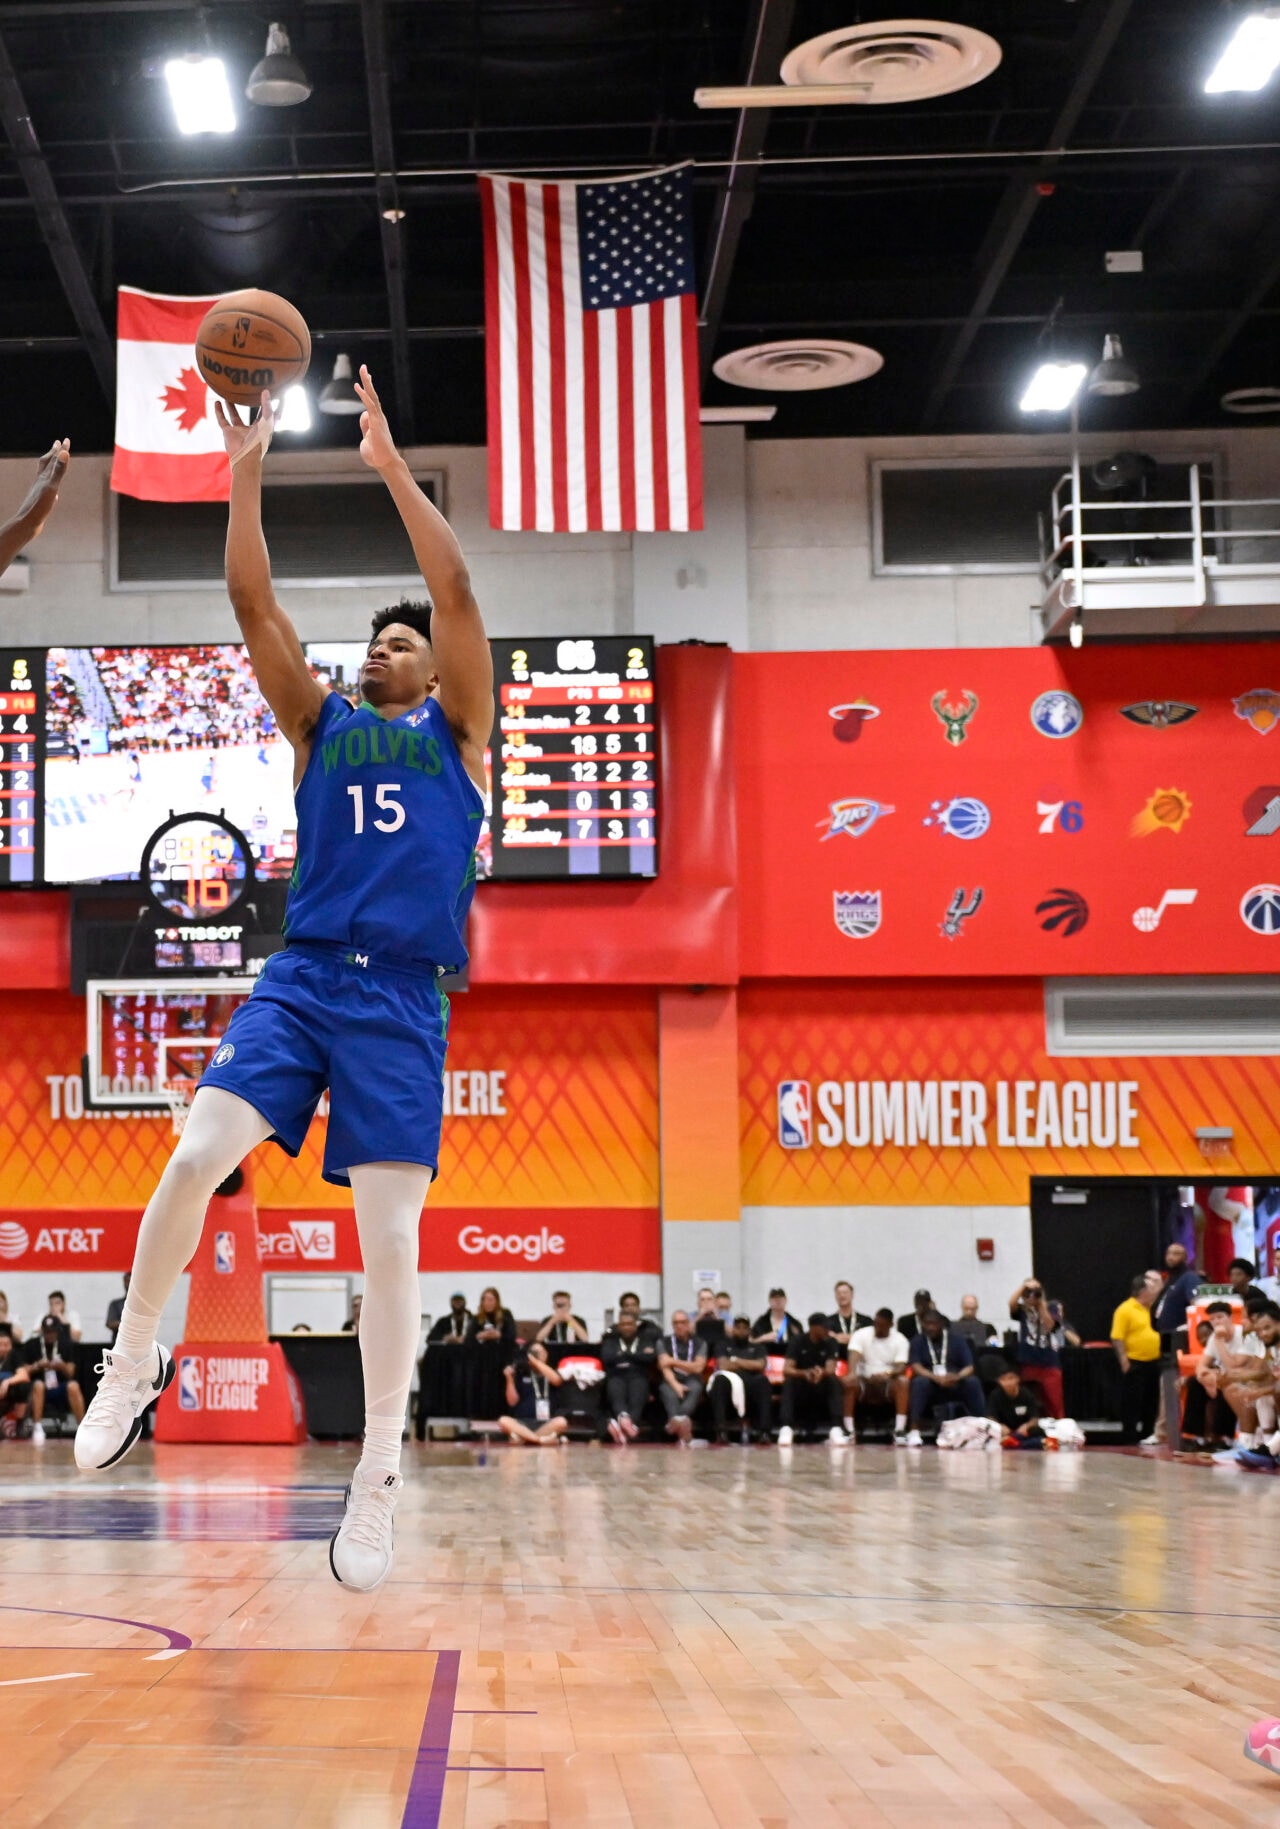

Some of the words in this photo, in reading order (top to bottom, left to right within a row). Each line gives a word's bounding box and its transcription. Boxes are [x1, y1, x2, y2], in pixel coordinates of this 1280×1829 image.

[511, 650, 527, 670] 2
[627, 648, 643, 668] 2
[13, 659, 28, 679] 5
[13, 714, 28, 734] 4
[575, 705, 591, 725] 2
[604, 704, 620, 724] 4
[634, 704, 645, 723] 1
[17, 743, 28, 762] 1
[322, 726, 442, 776] WOLVES
[571, 735, 597, 755] 18
[606, 734, 621, 754] 5
[635, 733, 646, 752] 1
[14, 771, 29, 791] 2
[571, 762, 597, 782] 12
[606, 762, 621, 782] 2
[632, 761, 648, 781] 2
[17, 800, 28, 820] 1
[347, 784, 406, 834] 15
[576, 791, 592, 811] 0
[610, 791, 621, 810] 1
[633, 791, 648, 811] 3
[1036, 800, 1084, 834] 76
[17, 828, 28, 847] 1
[577, 820, 592, 839] 7
[608, 820, 623, 840] 3
[638, 819, 649, 838] 1
[178, 926, 243, 941] TISSOT
[817, 1081, 987, 1147] SUMMER
[998, 1081, 1139, 1147] LEAGUE
[35, 1228, 104, 1253] AT&T
[258, 1225, 333, 1256] eraVe
[458, 1225, 565, 1261] Google
[207, 1357, 269, 1385] SUMMER
[206, 1384, 258, 1411] LEAGUE
